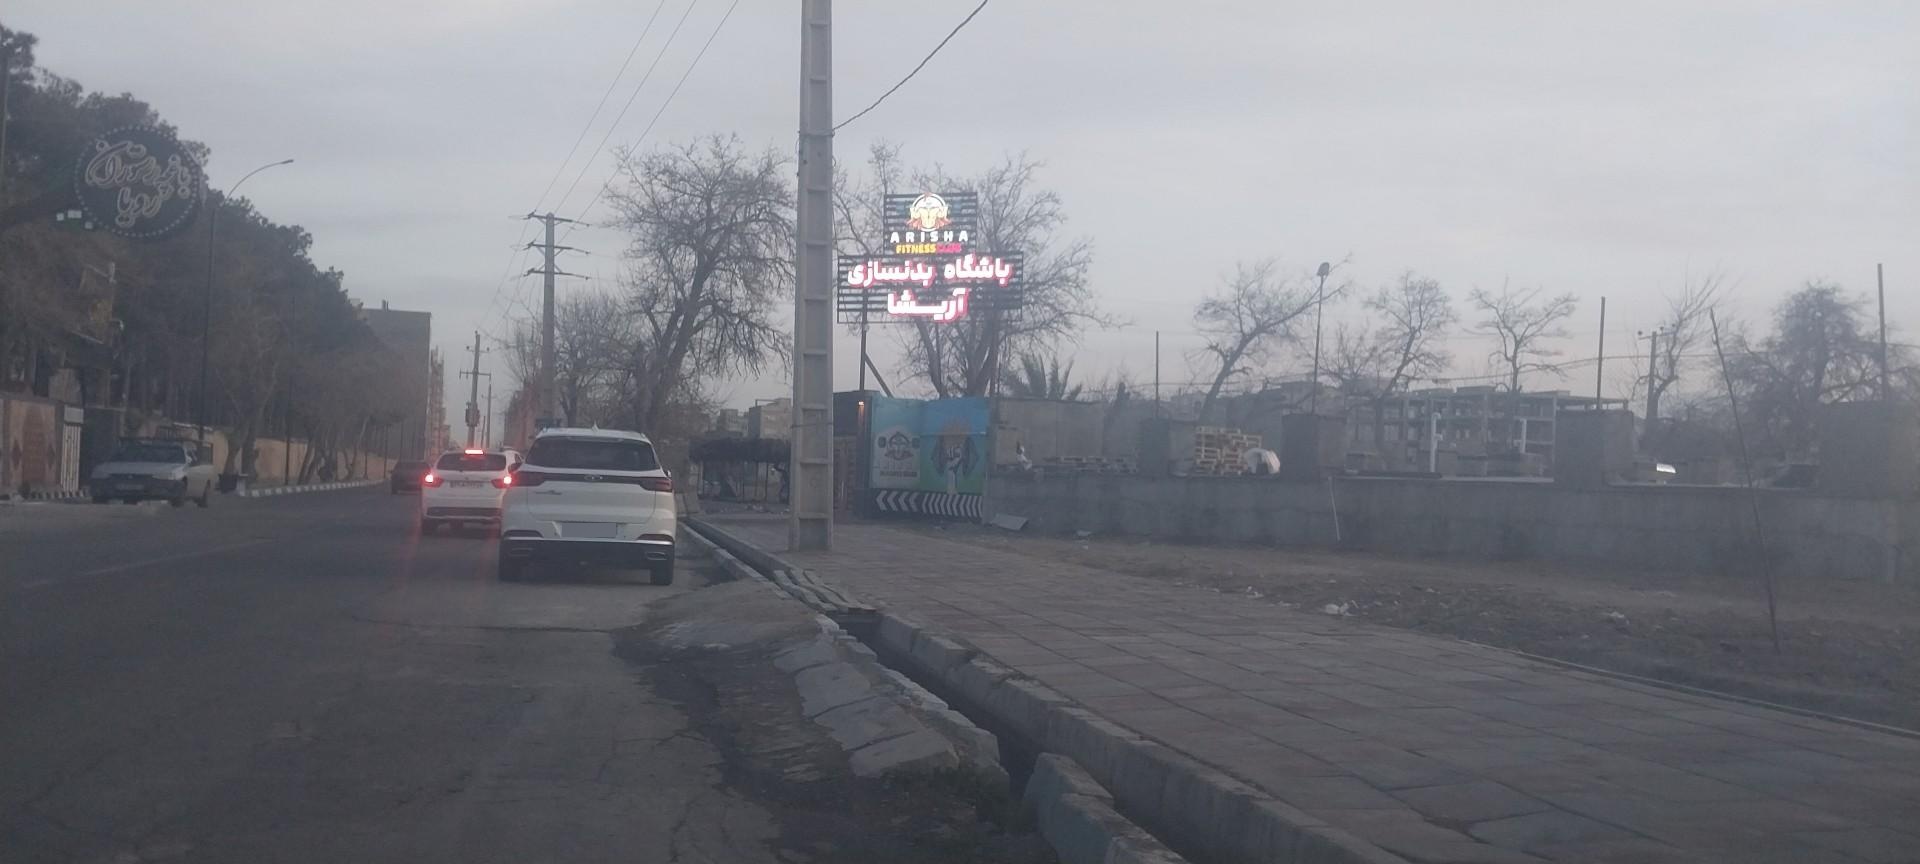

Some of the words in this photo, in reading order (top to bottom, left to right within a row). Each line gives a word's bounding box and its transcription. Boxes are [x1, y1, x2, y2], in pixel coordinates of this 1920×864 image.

[890, 230, 969, 243] ARISHA
[896, 243, 937, 254] FITNESS
[848, 260, 935, 287] بدنسازی
[944, 253, 1013, 286] باشگاه
[887, 288, 968, 322] آریشا
